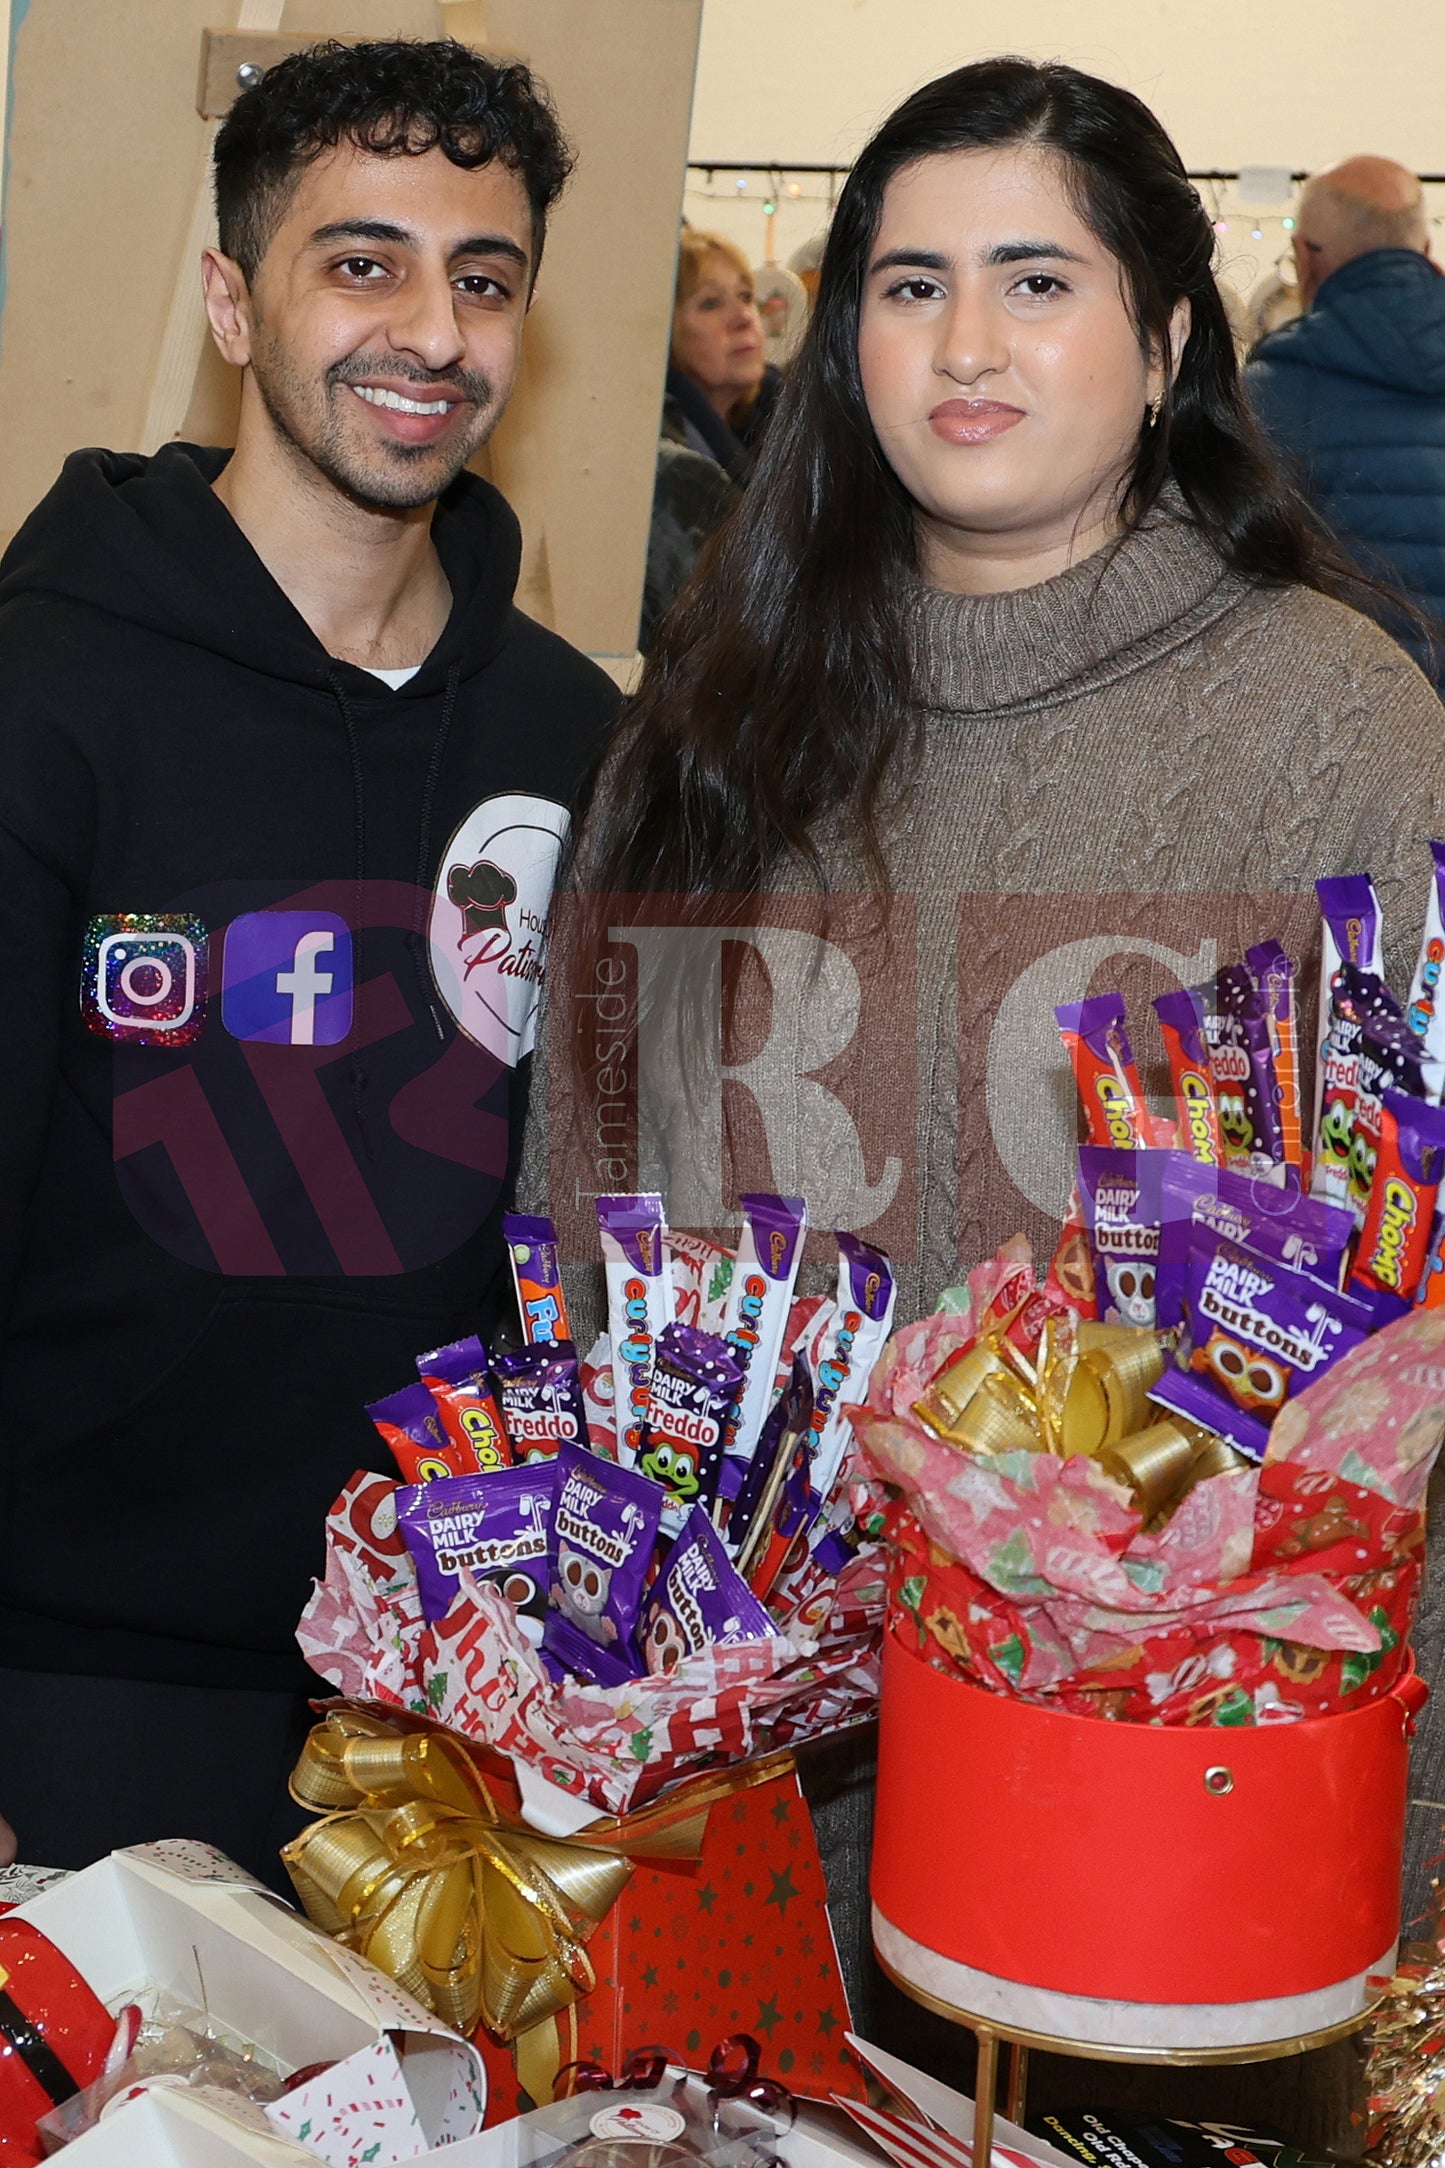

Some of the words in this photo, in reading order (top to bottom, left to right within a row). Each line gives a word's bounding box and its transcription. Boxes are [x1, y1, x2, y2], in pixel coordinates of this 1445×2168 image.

[1095, 1187, 1141, 1208] DAIRY
[1094, 1204, 1131, 1224] MILK
[1205, 1270, 1256, 1308] MILK
[1211, 1254, 1276, 1297] DAIRY
[1202, 1291, 1313, 1366] buttons
[651, 1384, 685, 1408] MILK
[653, 1370, 697, 1396] DAIRY
[504, 1410, 575, 1438] Freddo
[645, 1399, 715, 1444] Freddo
[559, 1491, 590, 1520] MILK
[564, 1477, 604, 1508] DAIRY
[428, 1510, 486, 1536] DAIRY
[556, 1510, 625, 1564] buttons
[432, 1527, 480, 1551] MILK
[438, 1537, 547, 1572] buttons
[686, 1542, 717, 1592] DAIRY
[678, 1551, 703, 1598] MILK
[1082, 2114, 1112, 2135] Old
[1082, 2131, 1112, 2153] Old
